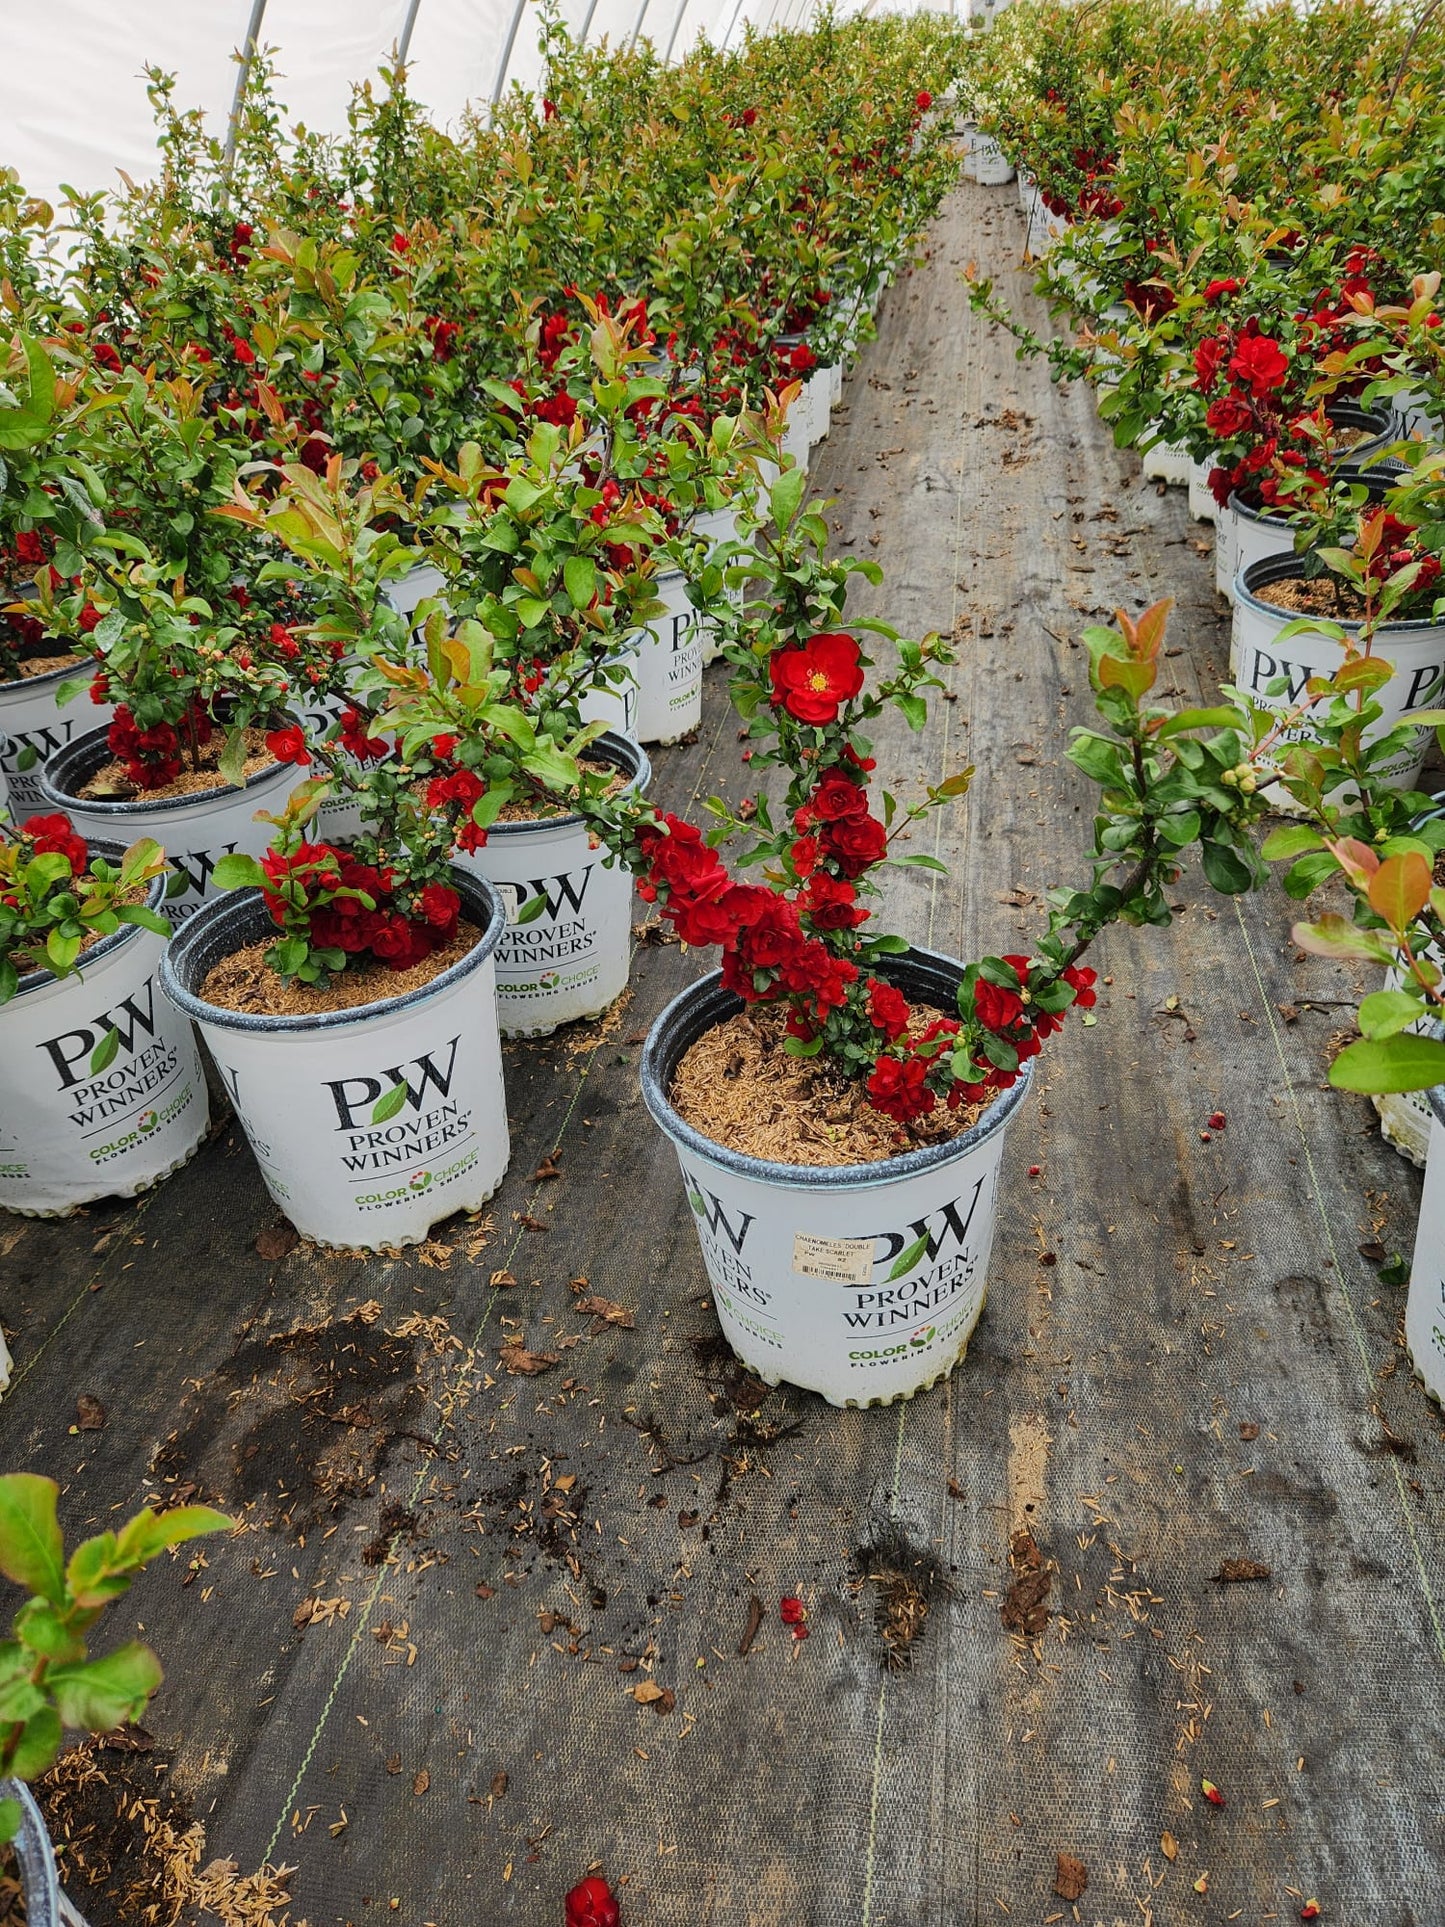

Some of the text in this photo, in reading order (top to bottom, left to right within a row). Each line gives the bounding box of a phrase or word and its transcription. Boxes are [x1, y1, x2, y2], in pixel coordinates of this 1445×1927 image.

[1399, 661, 1445, 711] P
[493, 932, 593, 964] WINNERS
[499, 918, 586, 946] PROVEN
[496, 966, 599, 993] COLOR CHOICE
[499, 975, 599, 1000] FLOWERING SHRUBS
[36, 974, 155, 1092] PW
[67, 1050, 178, 1128] WINNERS
[70, 1036, 167, 1107] PROVEN
[320, 1034, 462, 1131] PW
[89, 1084, 192, 1159] COLOR CHOICE
[95, 1092, 193, 1166] FLOWERING SHRUBS
[340, 1114, 469, 1172] WINNERS
[347, 1099, 458, 1151] PROVEN
[354, 1149, 478, 1205] COLOR CHOICE
[358, 1159, 480, 1212] FLOWERING SHRUBS
[808, 1244, 855, 1257] TAKE SCARLET
[856, 1245, 970, 1309] PROVEN
[841, 1261, 975, 1328] WINNERS
[848, 1344, 907, 1360] COLOR
[850, 1345, 933, 1368] FLOWERING
